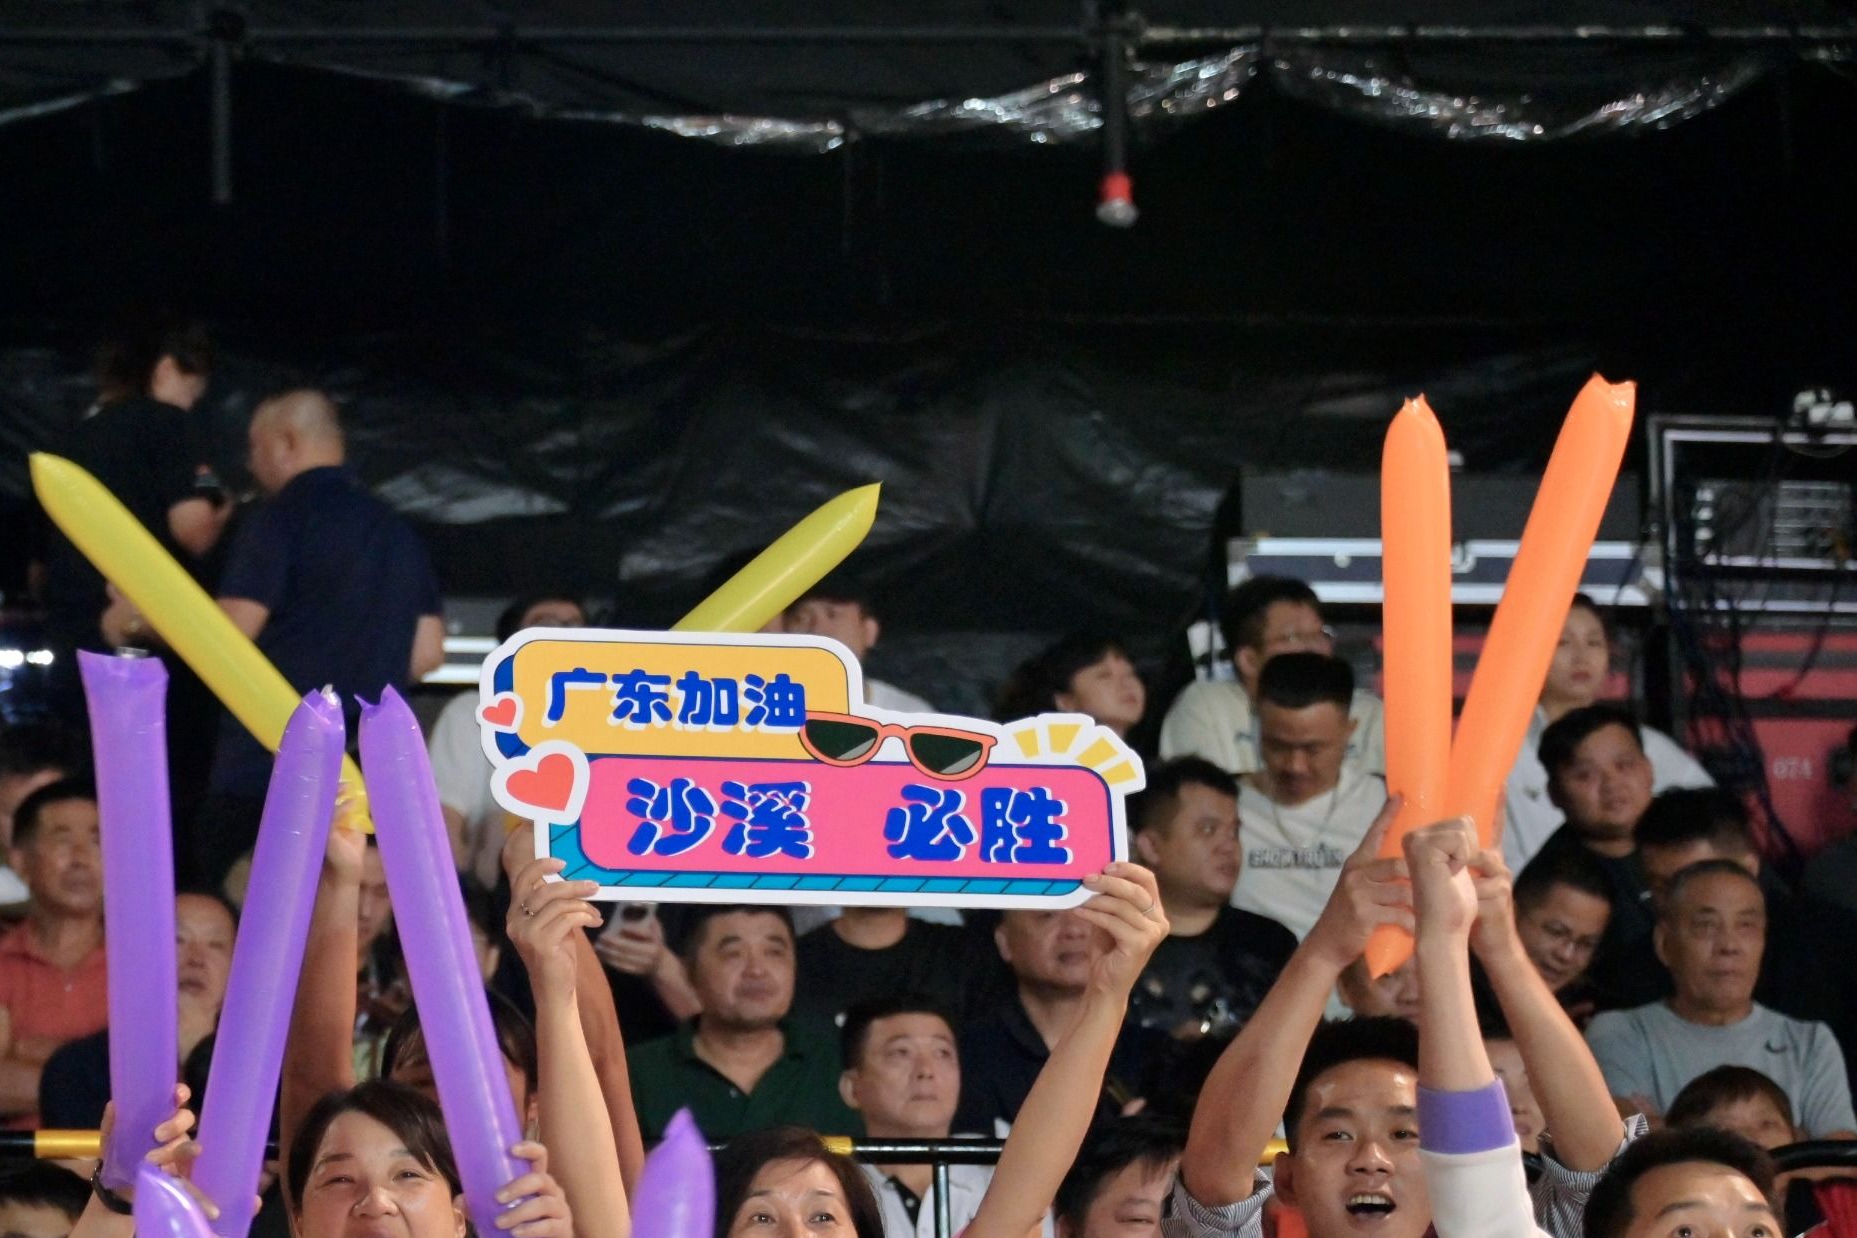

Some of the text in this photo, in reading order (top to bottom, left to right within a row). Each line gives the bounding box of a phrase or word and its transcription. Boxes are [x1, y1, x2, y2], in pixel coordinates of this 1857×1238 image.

[543, 667, 806, 732] 广东加油
[626, 777, 1073, 865] 沙溪 必胜
